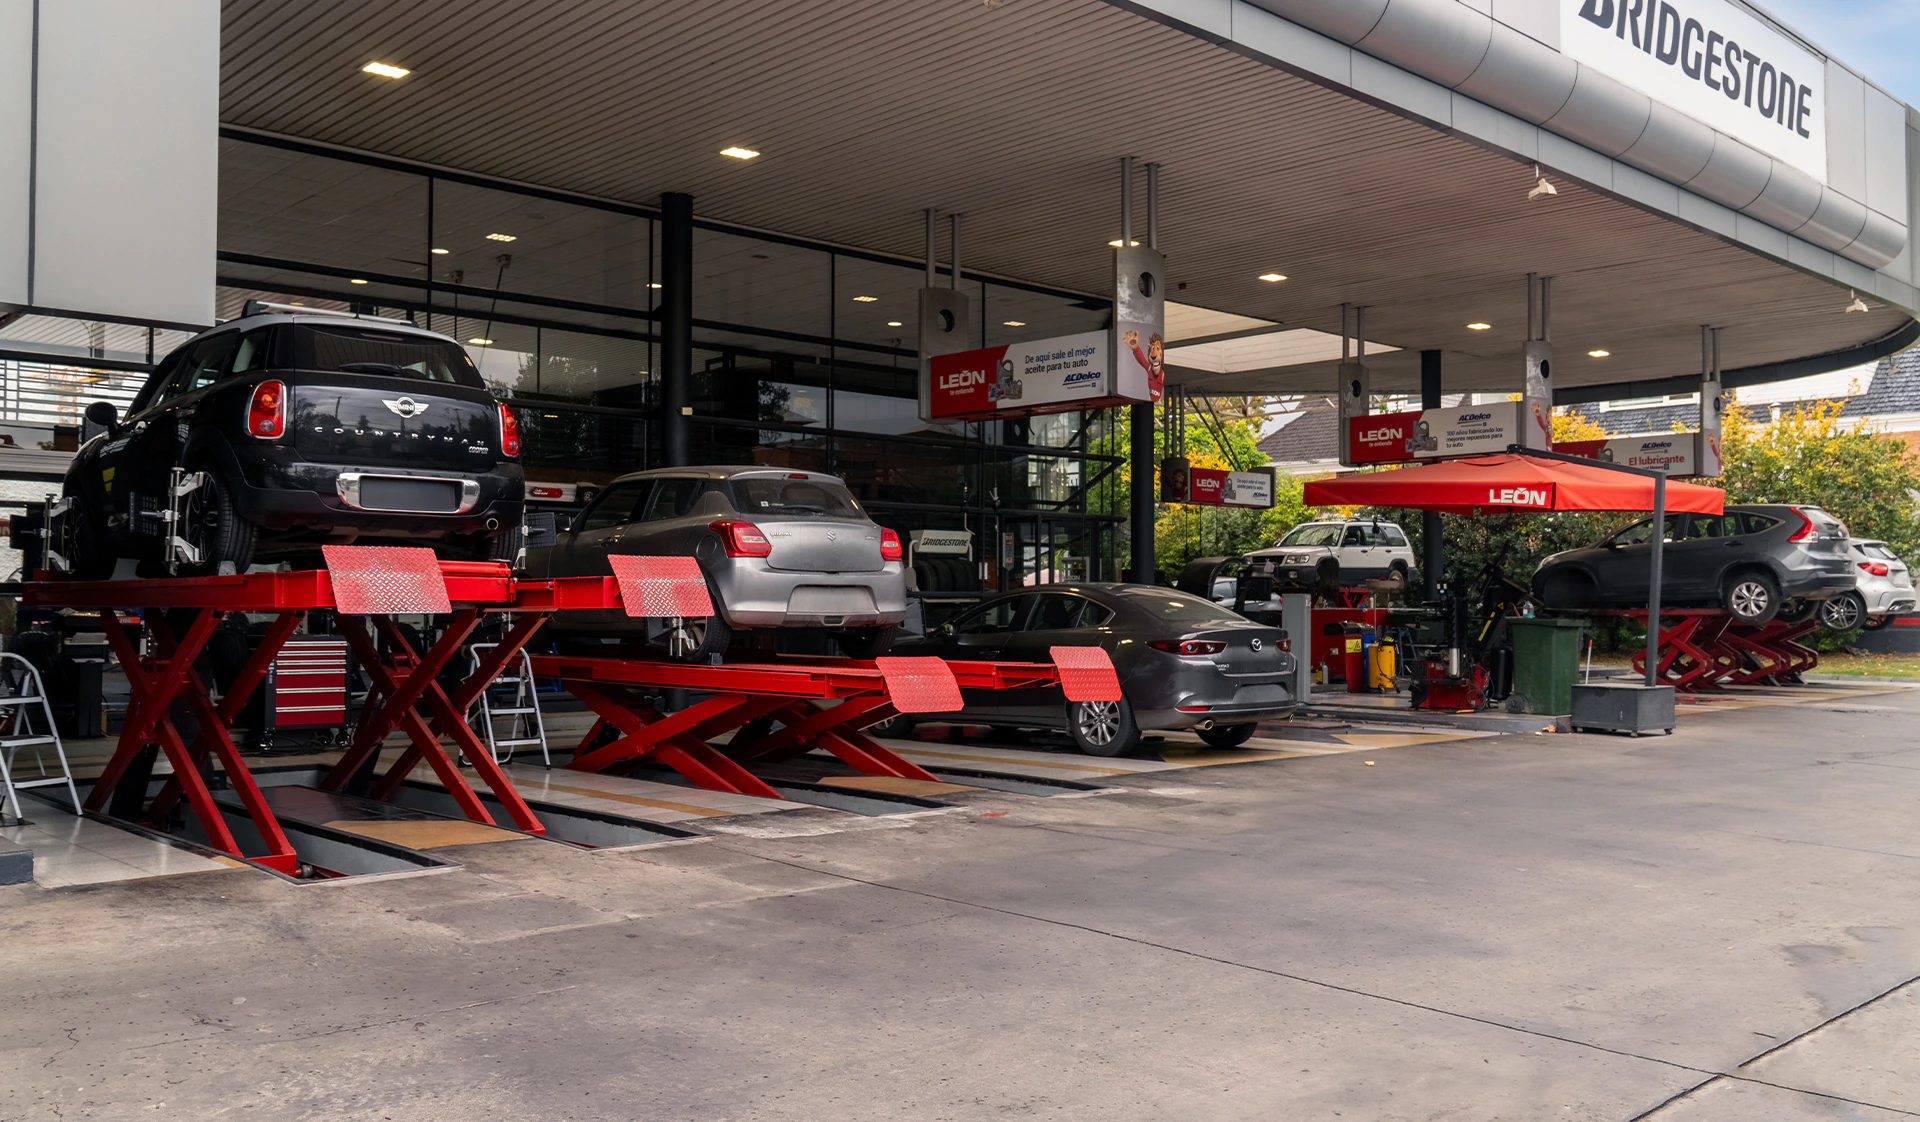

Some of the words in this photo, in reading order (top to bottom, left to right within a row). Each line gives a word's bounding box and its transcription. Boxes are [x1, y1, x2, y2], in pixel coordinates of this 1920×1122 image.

[1025, 355, 1034, 364] De
[1035, 352, 1050, 364] aquí
[1051, 350, 1065, 359] sale
[1067, 348, 1074, 358] el
[1075, 346, 1096, 357] mejor
[1024, 364, 1045, 375] aceite
[1046, 362, 1062, 373] para
[1063, 360, 1071, 369] tu
[1072, 358, 1089, 368] auto
[1064, 371, 1101, 383] ACDelco
[955, 387, 975, 396] entiende
[399, 404, 415, 412] MINI
[1458, 413, 1492, 422] ACDelco
[314, 427, 485, 446] COUNTRYMAN
[468, 446, 489, 454] COOPER
[1641, 441, 1672, 449] ACDelco
[1629, 457, 1637, 466] El
[1639, 455, 1685, 466] lubricante
[921, 537, 969, 547] BRIDGESTONE
